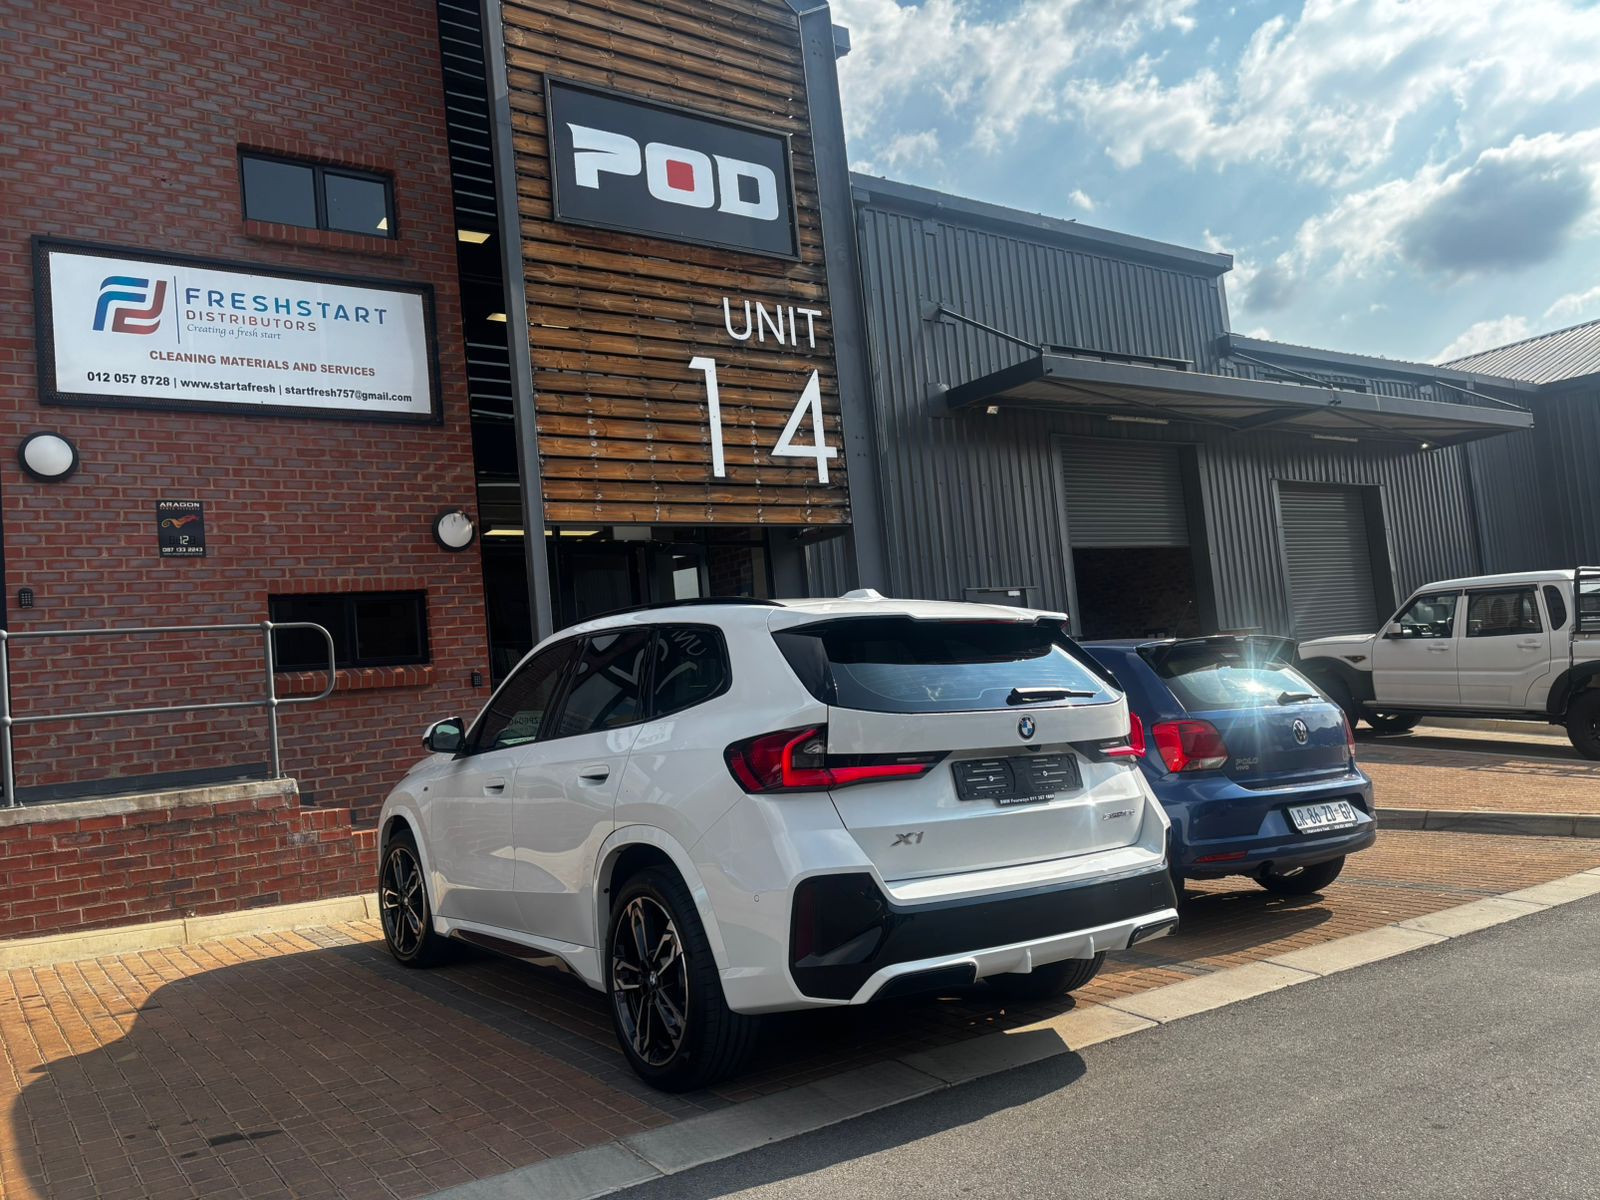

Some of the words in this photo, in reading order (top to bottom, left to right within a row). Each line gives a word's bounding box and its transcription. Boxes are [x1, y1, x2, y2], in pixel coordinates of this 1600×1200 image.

[566, 122, 779, 221] POD
[185, 287, 387, 325] FRESHSTART
[186, 309, 317, 332] DISTRIBUTORS
[186, 323, 227, 338] Creating
[235, 326, 258, 340] fresh
[260, 331, 282, 340] start
[722, 296, 822, 349] UNIT
[149, 350, 217, 364] CLEANING
[220, 356, 290, 371] MATERIALS
[292, 362, 318, 373] AND
[320, 364, 376, 377] SERVICES
[87, 371, 111, 383] 012
[114, 373, 137, 384] 057
[140, 375, 170, 387] 8728
[180, 378, 276, 394] www.startafresh
[284, 386, 412, 403] startfresh757@gmail.com
[688, 356, 838, 484] 14
[179, 535, 190, 545] 12
[1290, 805, 1309, 827] LR
[1306, 803, 1322, 824] 86
[1320, 800, 1336, 823] ZD
[1338, 798, 1352, 820] GP
[890, 831, 925, 847] X1
